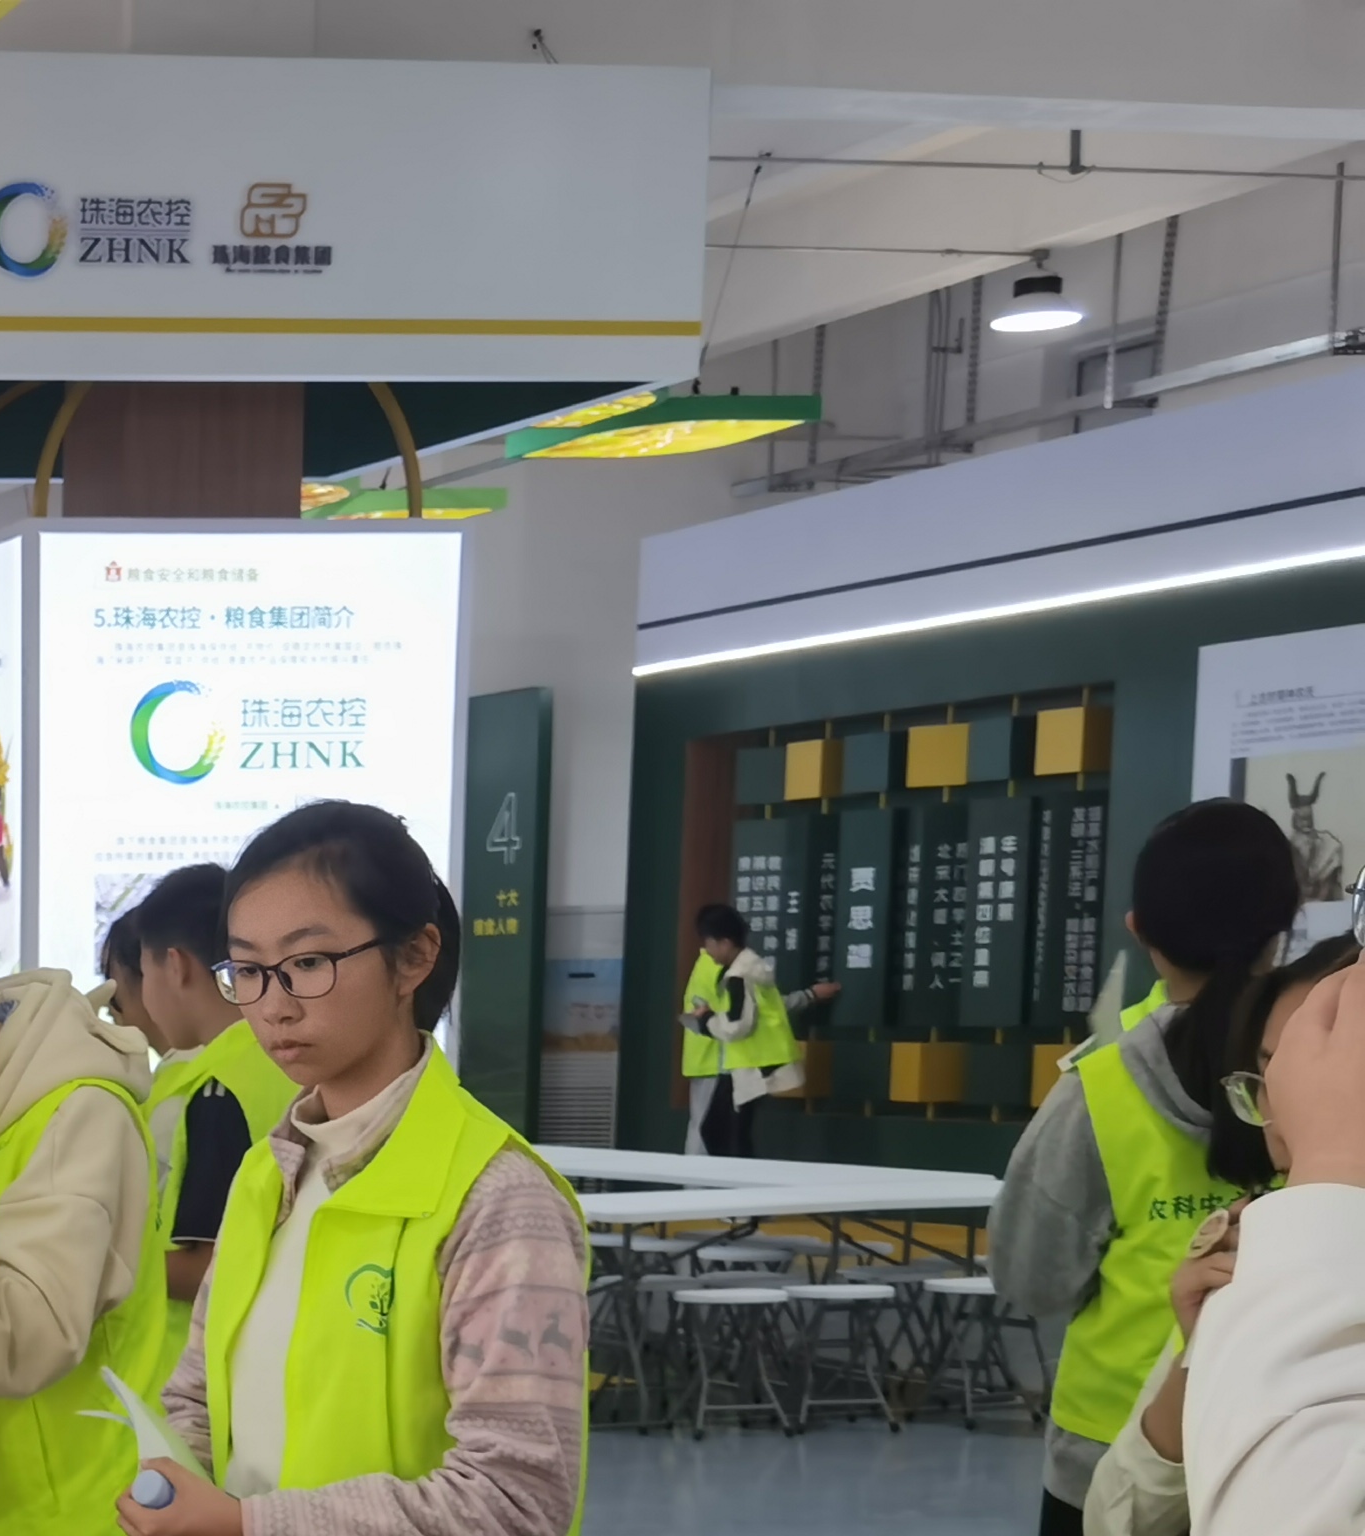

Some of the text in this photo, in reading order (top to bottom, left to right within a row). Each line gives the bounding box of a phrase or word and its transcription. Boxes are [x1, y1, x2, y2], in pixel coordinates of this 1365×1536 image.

[79, 197, 193, 227] 珠海农控
[78, 236, 192, 265] ZHNK
[240, 697, 368, 729] 珠海农控
[238, 740, 366, 770] ZHNK
[485, 791, 523, 866] 4
